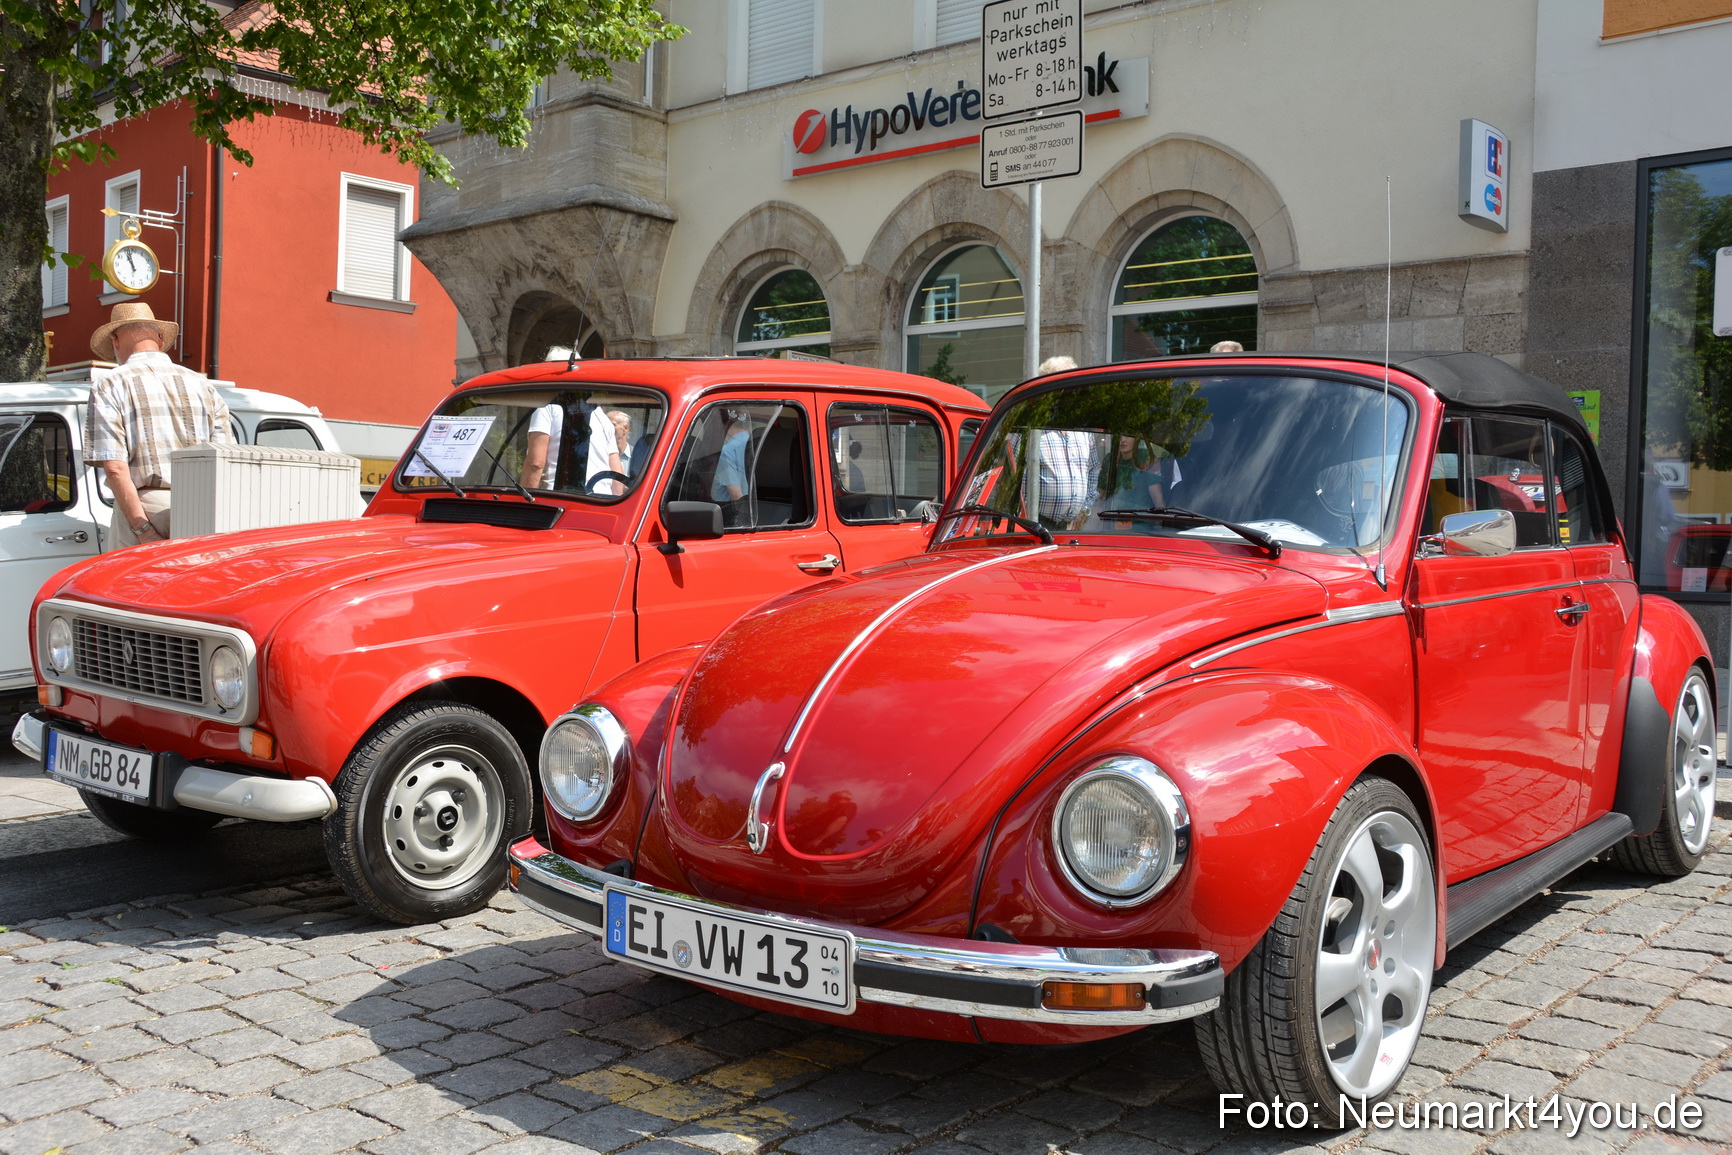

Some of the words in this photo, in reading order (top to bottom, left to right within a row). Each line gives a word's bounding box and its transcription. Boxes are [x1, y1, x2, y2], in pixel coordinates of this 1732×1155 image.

[1003, 6, 1028, 23] nur
[1035, 0, 1060, 15] mit
[989, 13, 1073, 45] Parkschein
[996, 35, 1067, 62] werktags
[988, 93, 1004, 108] Sa
[1004, 129, 1016, 138] Std.
[1018, 126, 1029, 135] mit
[1029, 121, 1065, 133] Parkschein
[1024, 134, 1037, 142] oder
[988, 147, 1008, 158] Anruf
[1005, 163, 1021, 173] SMS
[1022, 162, 1032, 171] an
[452, 428, 477, 441] 487
[60, 738, 80, 775] NM
[90, 747, 113, 783] GB
[116, 753, 142, 791] 84
[613, 928, 621, 943] D
[628, 903, 668, 960] EI
[695, 919, 745, 977] VW
[756, 933, 810, 989] 13
[820, 945, 839, 962] 04
[822, 980, 840, 997] 10
